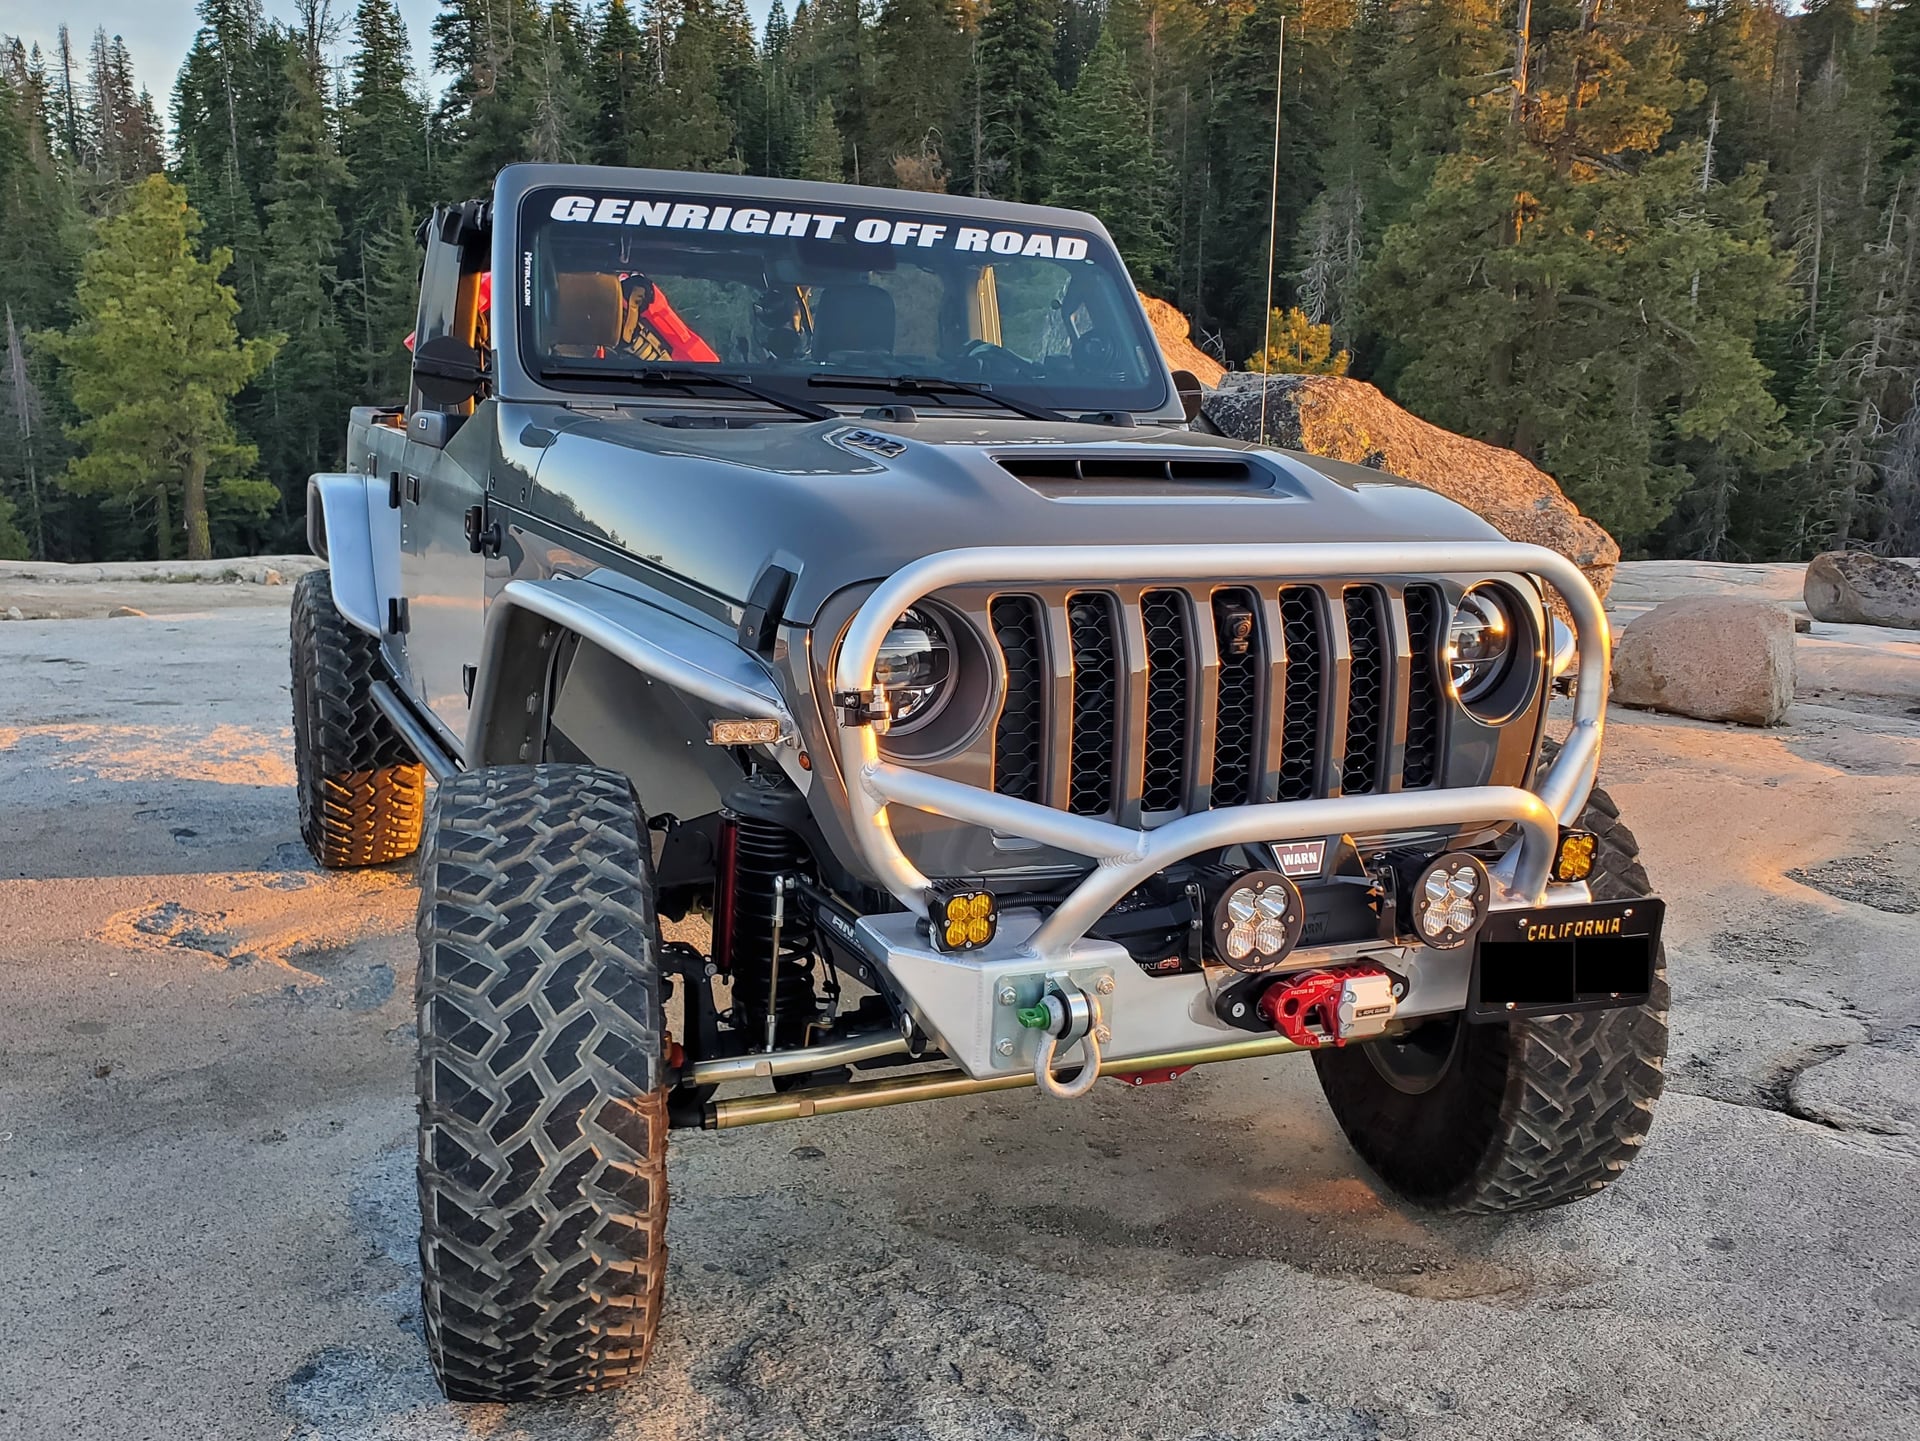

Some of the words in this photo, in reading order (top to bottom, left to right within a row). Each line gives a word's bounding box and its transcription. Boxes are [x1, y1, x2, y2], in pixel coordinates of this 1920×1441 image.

[550, 196, 846, 239] GENRIGHT
[855, 219, 947, 247] OFF
[955, 227, 1089, 260] ROAD
[1282, 852, 1318, 867] WARN
[1527, 917, 1622, 942] CALIFORNIA
